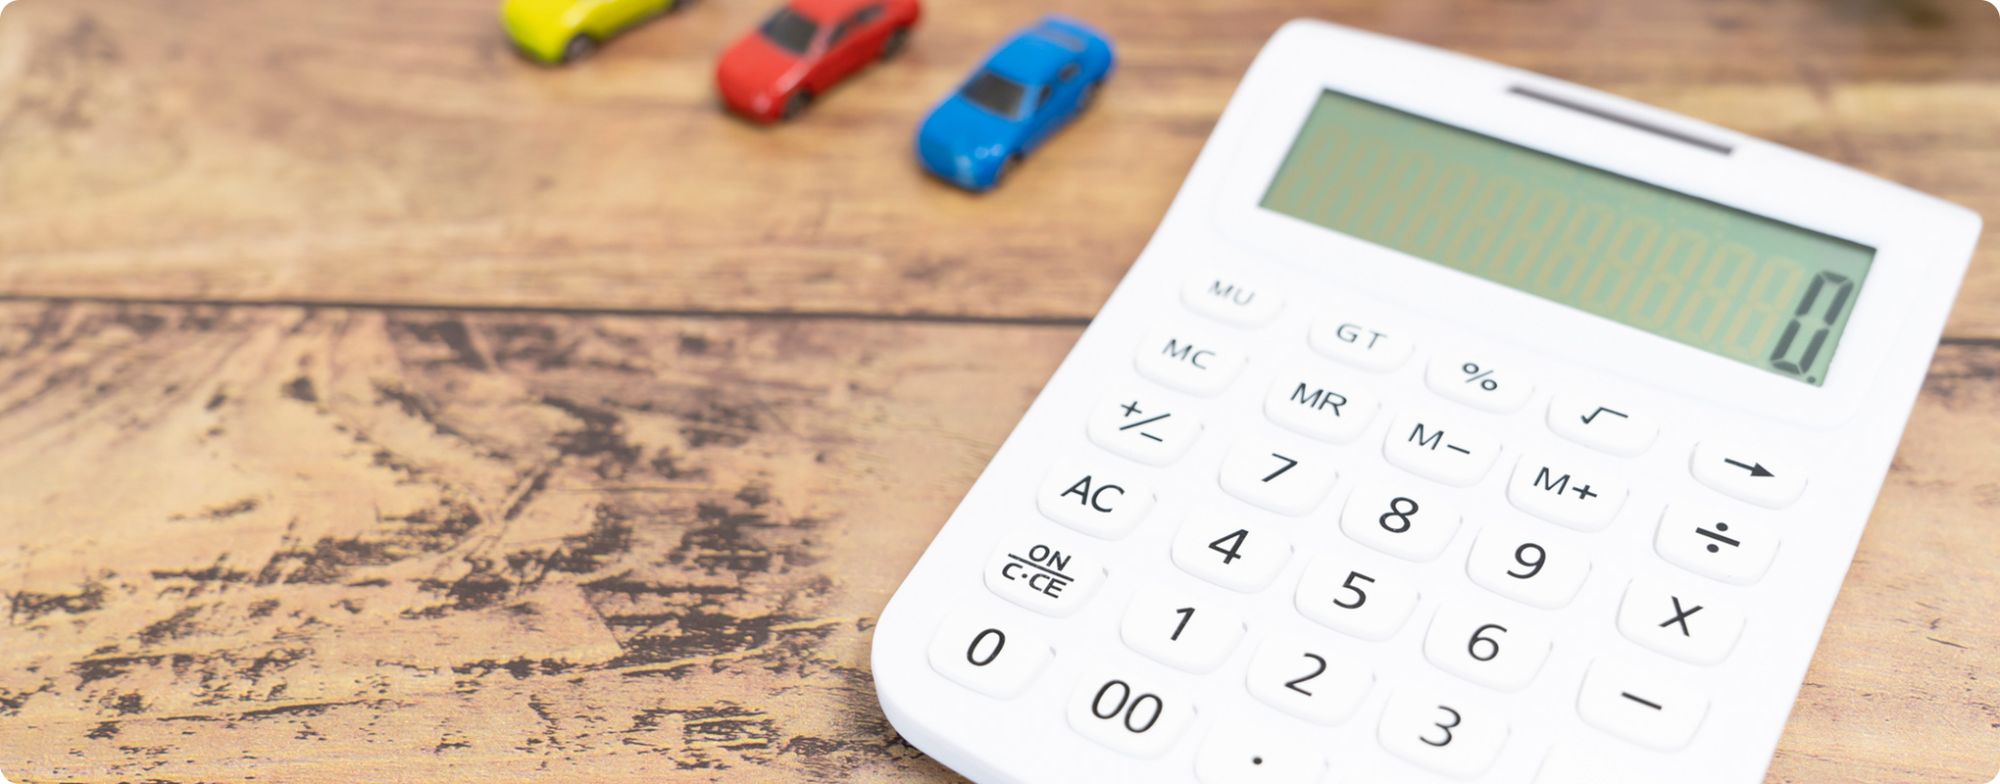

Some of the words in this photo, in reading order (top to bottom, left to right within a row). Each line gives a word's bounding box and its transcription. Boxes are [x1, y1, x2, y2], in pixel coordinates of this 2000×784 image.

[1208, 279, 1257, 307] MU
[1161, 338, 1217, 371] MC
[1336, 321, 1389, 351] GT
[1461, 361, 1499, 392] %
[1290, 381, 1349, 418] MR
[1261, 452, 1299, 484] 7
[1532, 465, 1599, 501] M+
[1059, 474, 1126, 514] AC
[1378, 495, 1420, 535] 8
[1027, 543, 1072, 573] ON
[1208, 527, 1250, 566] 4
[1506, 541, 1548, 581] 9
[1332, 570, 1377, 611] 5
[1169, 606, 1197, 643] 1
[1467, 623, 1509, 663] 6
[965, 627, 1007, 668] 0
[1284, 652, 1328, 698] 2
[1090, 678, 1164, 735] 00
[1419, 705, 1463, 748] 3
